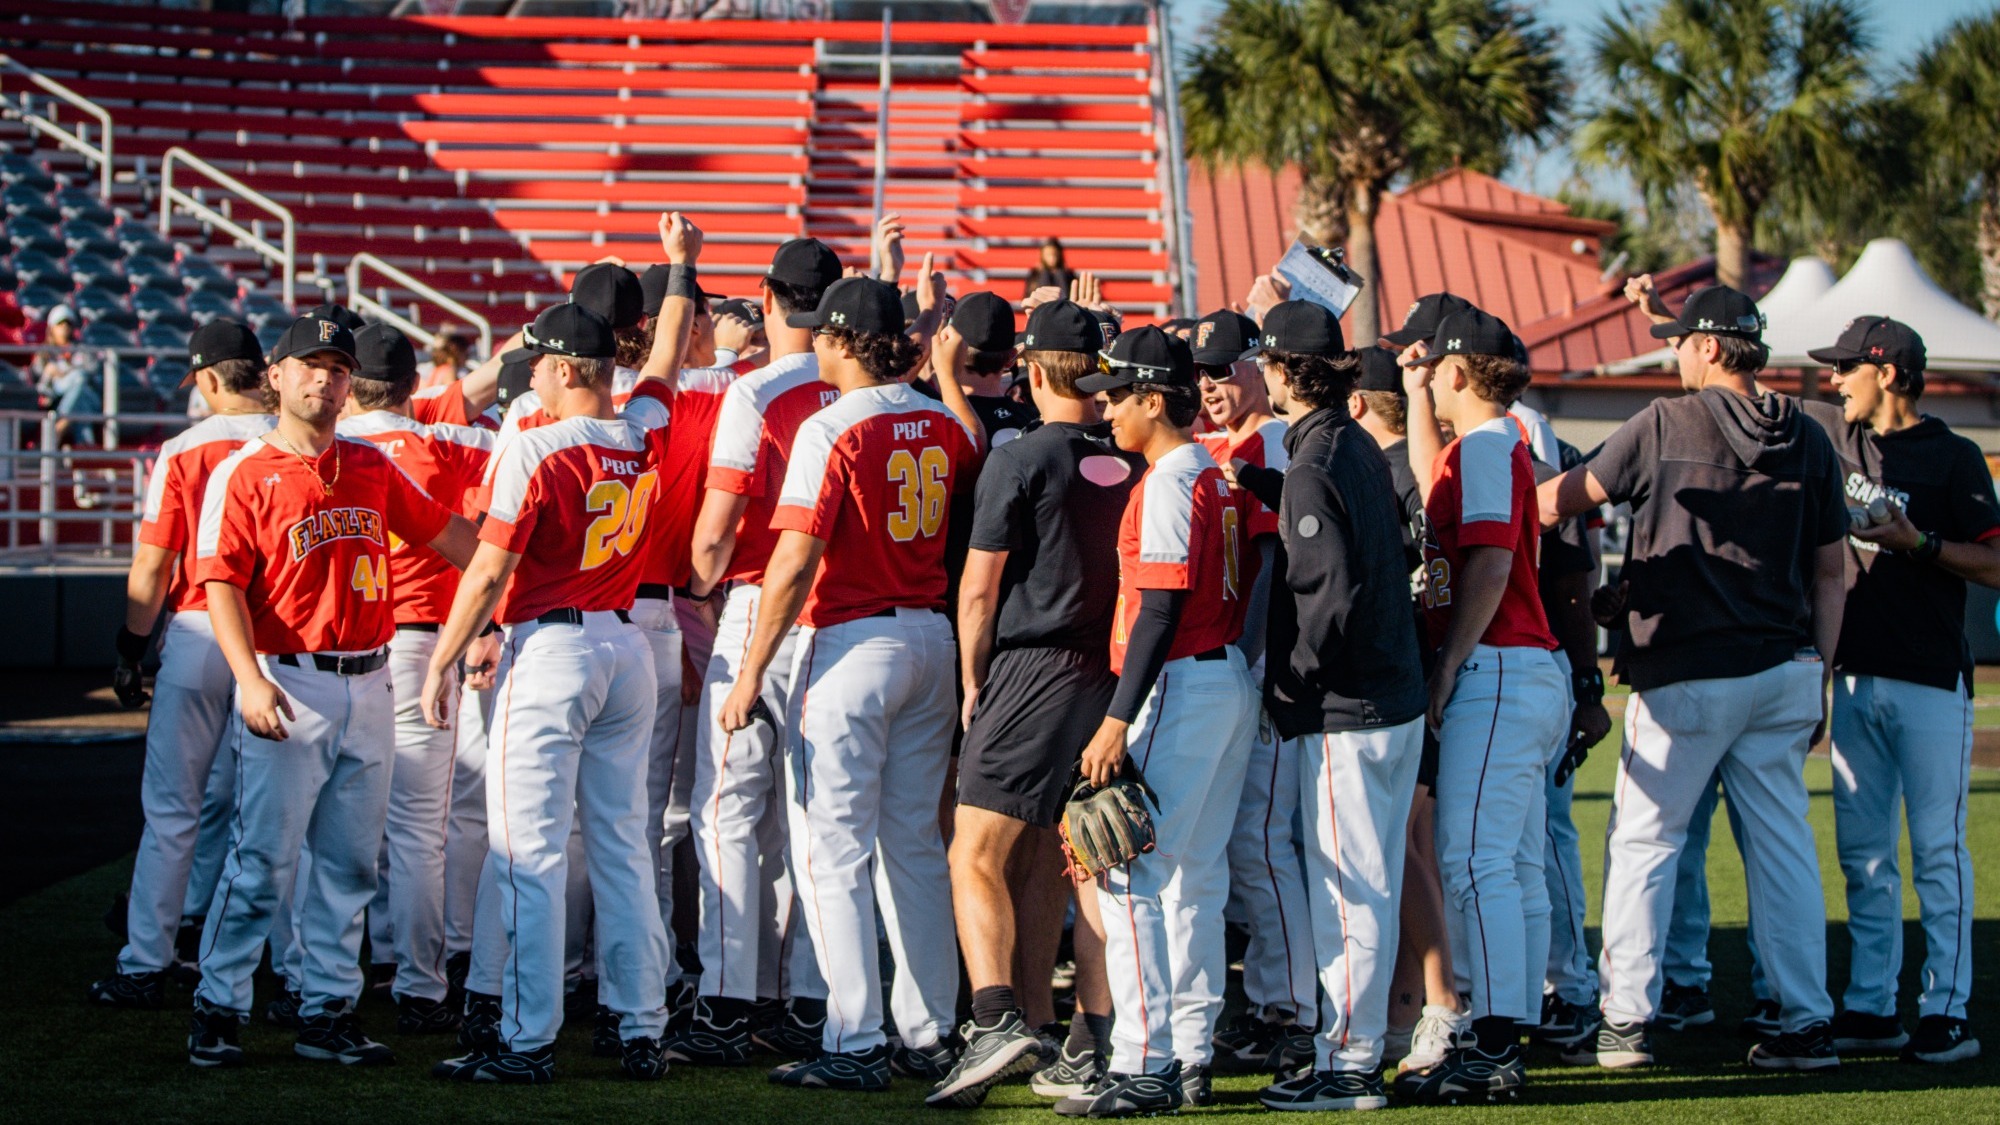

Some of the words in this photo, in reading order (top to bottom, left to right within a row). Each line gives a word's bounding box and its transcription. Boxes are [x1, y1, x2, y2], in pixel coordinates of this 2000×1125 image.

[319, 320, 339, 342] F
[1197, 321, 1216, 348] F
[893, 420, 931, 440] PBC
[601, 456, 642, 475] PBC
[886, 446, 949, 542] 36
[288, 507, 384, 563] FLAGLER
[580, 469, 658, 571] 20
[351, 553, 388, 602] 44
